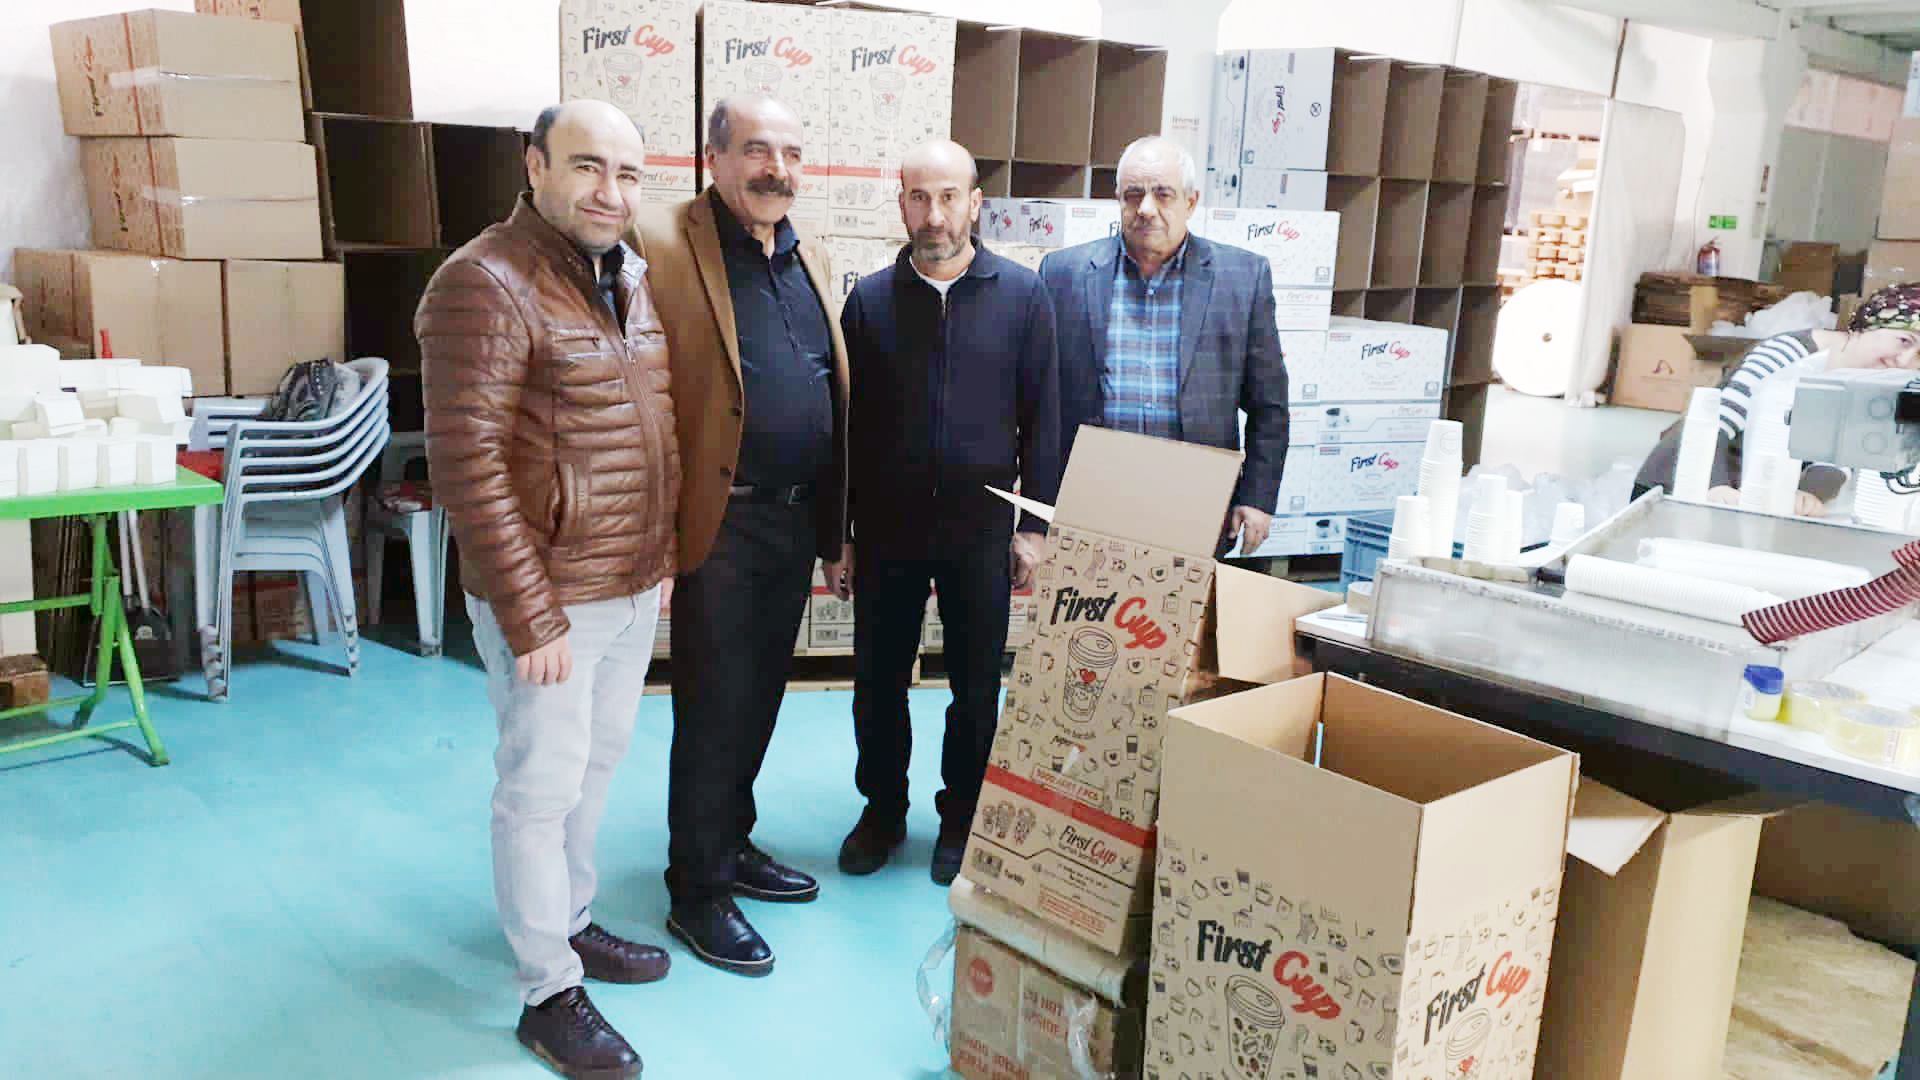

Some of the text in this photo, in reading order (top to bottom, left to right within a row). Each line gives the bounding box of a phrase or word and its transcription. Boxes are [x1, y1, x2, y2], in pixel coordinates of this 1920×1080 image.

[582, 24, 675, 57] First Cup
[724, 35, 813, 67] First Cup
[850, 45, 937, 75] First Cup
[1247, 220, 1300, 241] First Cup
[1361, 340, 1412, 360] First Cup
[1350, 452, 1400, 473] First Cup
[1050, 586, 1168, 650] First Cup
[1059, 824, 1093, 850] First
[1090, 839, 1118, 866] Cup
[1197, 920, 1342, 1020] First Cup
[1422, 950, 1533, 1047] First Cup
